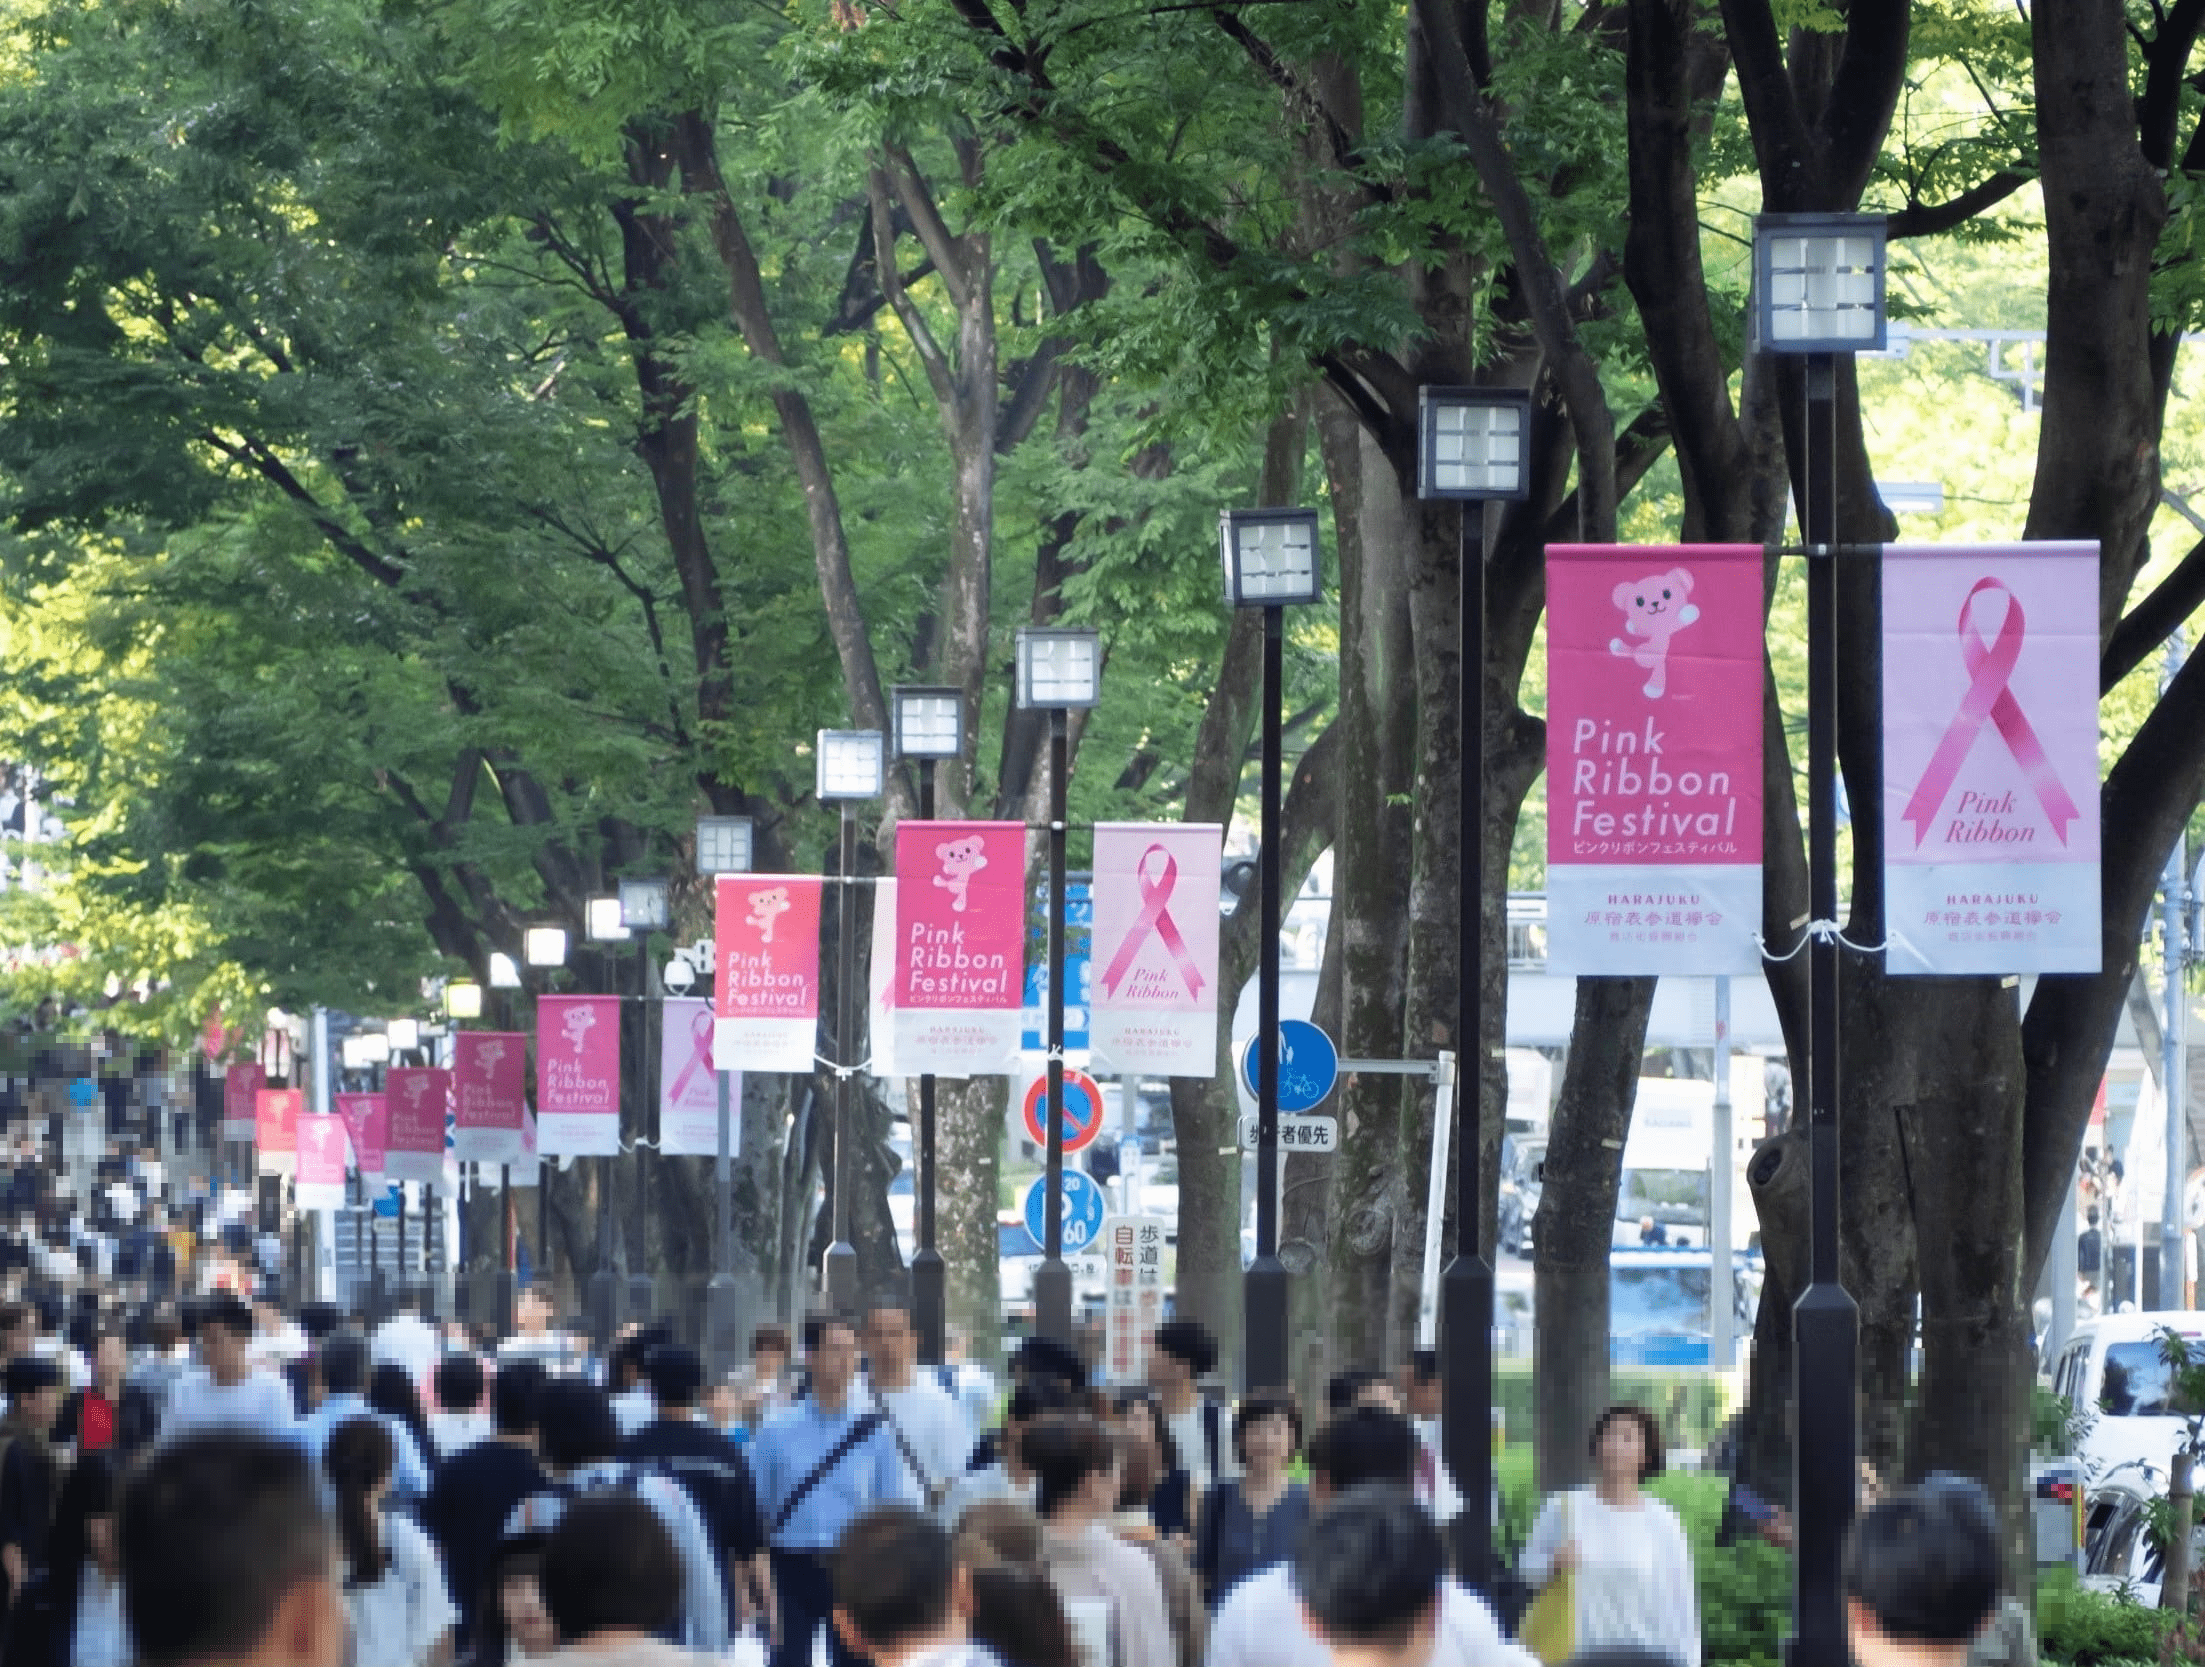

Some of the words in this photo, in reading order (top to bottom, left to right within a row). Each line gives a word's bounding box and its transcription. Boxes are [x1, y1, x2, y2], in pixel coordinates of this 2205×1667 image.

[1573, 716, 1665, 754] Pink
[1573, 756, 1730, 796] Ribbon
[1958, 790, 2016, 814] Pink
[1573, 797, 1737, 836] Festival
[1945, 819, 2035, 844] Ribbon
[1607, 894, 1700, 906] HARAJUKU
[1946, 894, 2038, 905] HARAJUKU
[911, 920, 965, 944] Pink
[728, 948, 773, 969] Pink
[911, 944, 1003, 969] Ribbon
[728, 968, 804, 988] Ribbon
[911, 969, 1008, 993] Festival
[728, 985, 807, 1006] Festival
[1249, 1125, 1328, 1145] 歩者優先
[1063, 1220, 1086, 1245] 60
